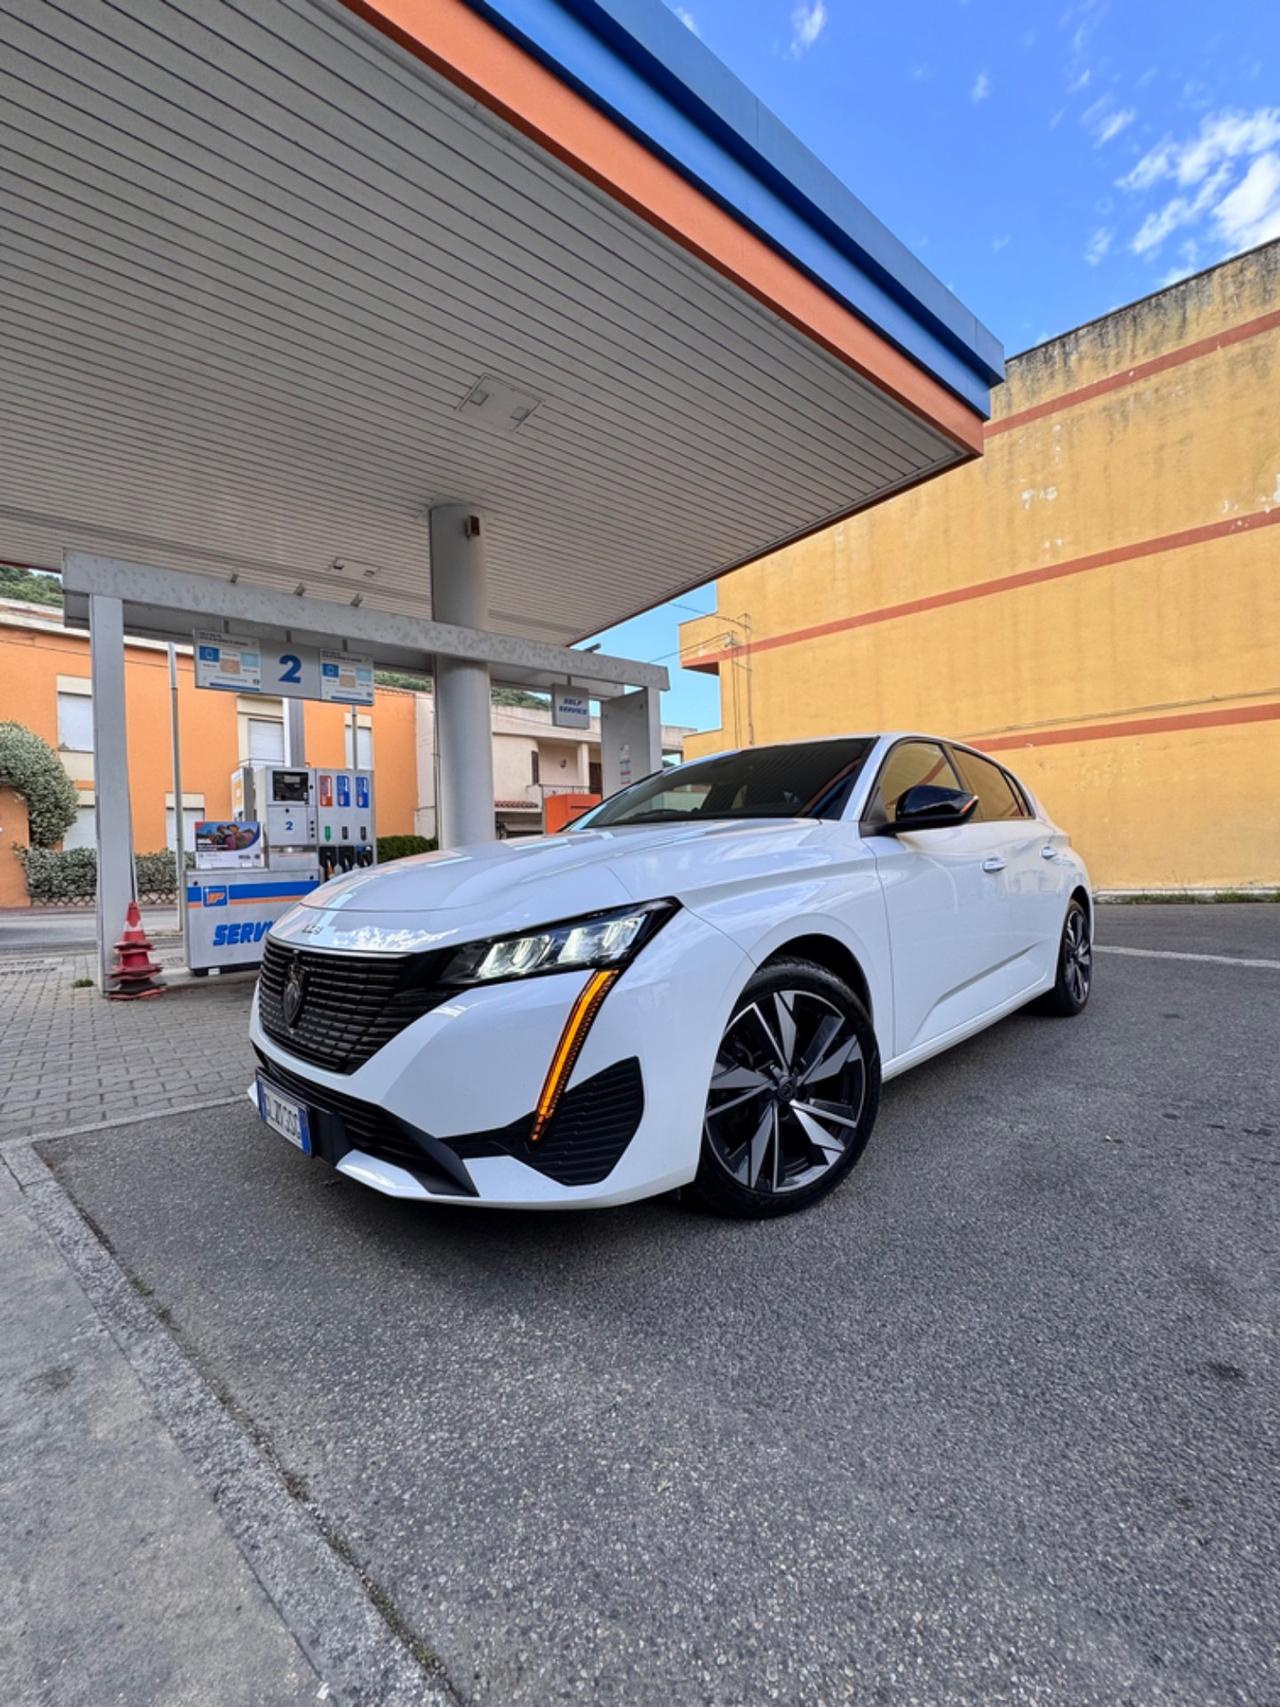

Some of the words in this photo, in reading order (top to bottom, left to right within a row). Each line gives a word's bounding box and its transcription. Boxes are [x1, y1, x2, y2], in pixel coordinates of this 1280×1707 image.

[278, 654, 302, 684] 2
[285, 820, 293, 831] 2
[213, 920, 273, 946] SERV
